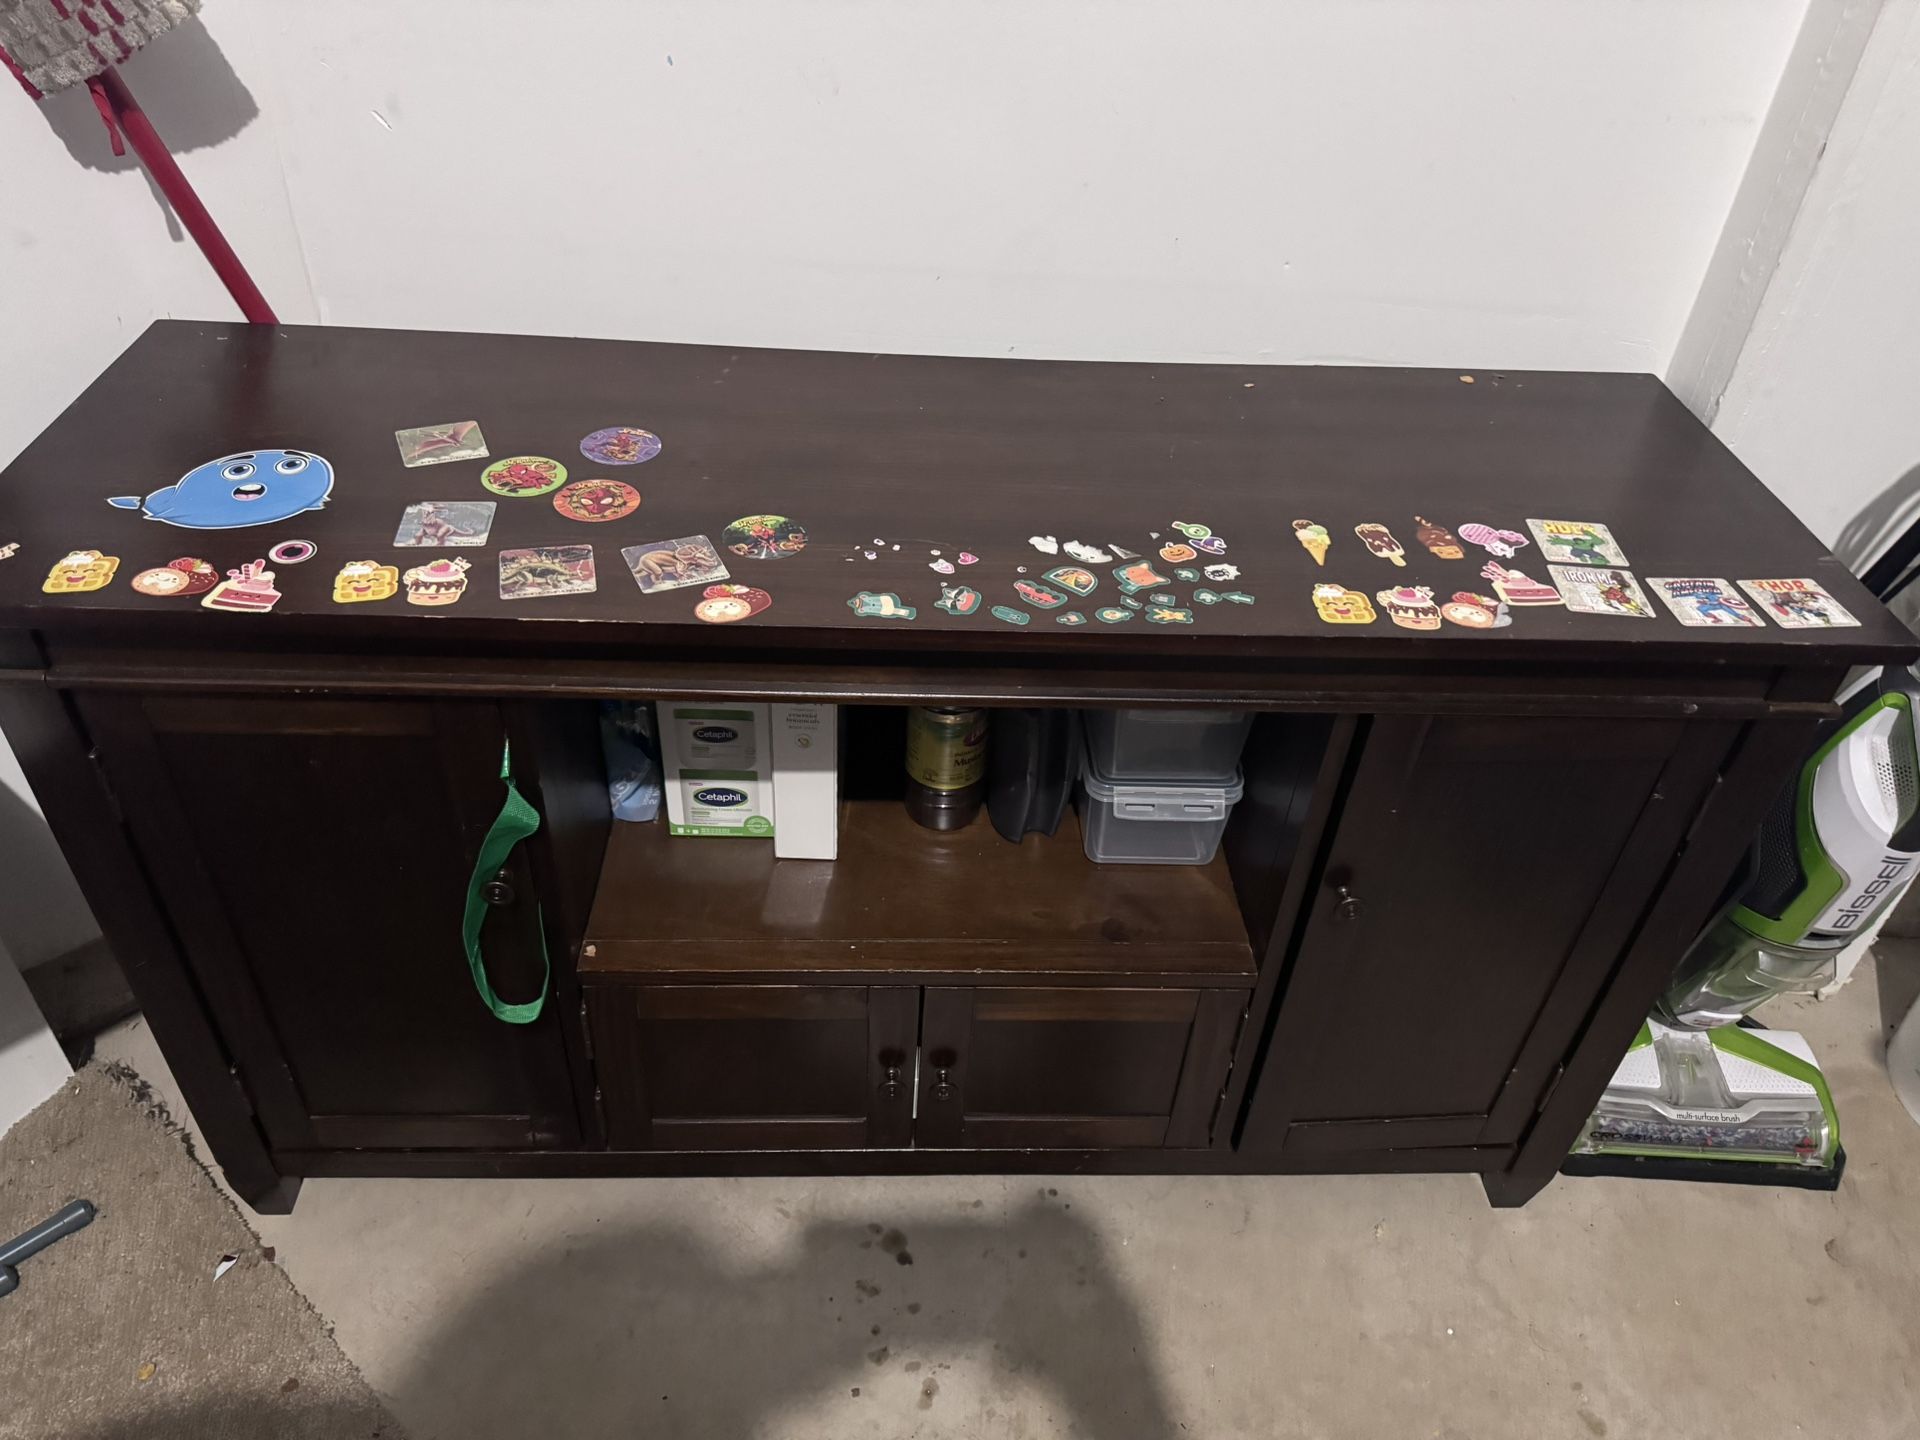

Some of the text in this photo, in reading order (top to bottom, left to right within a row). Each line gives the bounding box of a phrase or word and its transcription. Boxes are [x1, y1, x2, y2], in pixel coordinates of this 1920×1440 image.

[1562, 570, 1596, 584] IRON
[1664, 580, 1716, 591] CAPTAIN
[1754, 580, 1807, 592] THOR
[696, 730, 733, 739] Cetaphil
[698, 792, 742, 802] Cetaphil
[1676, 1111, 1741, 1123] multi-surface brush
